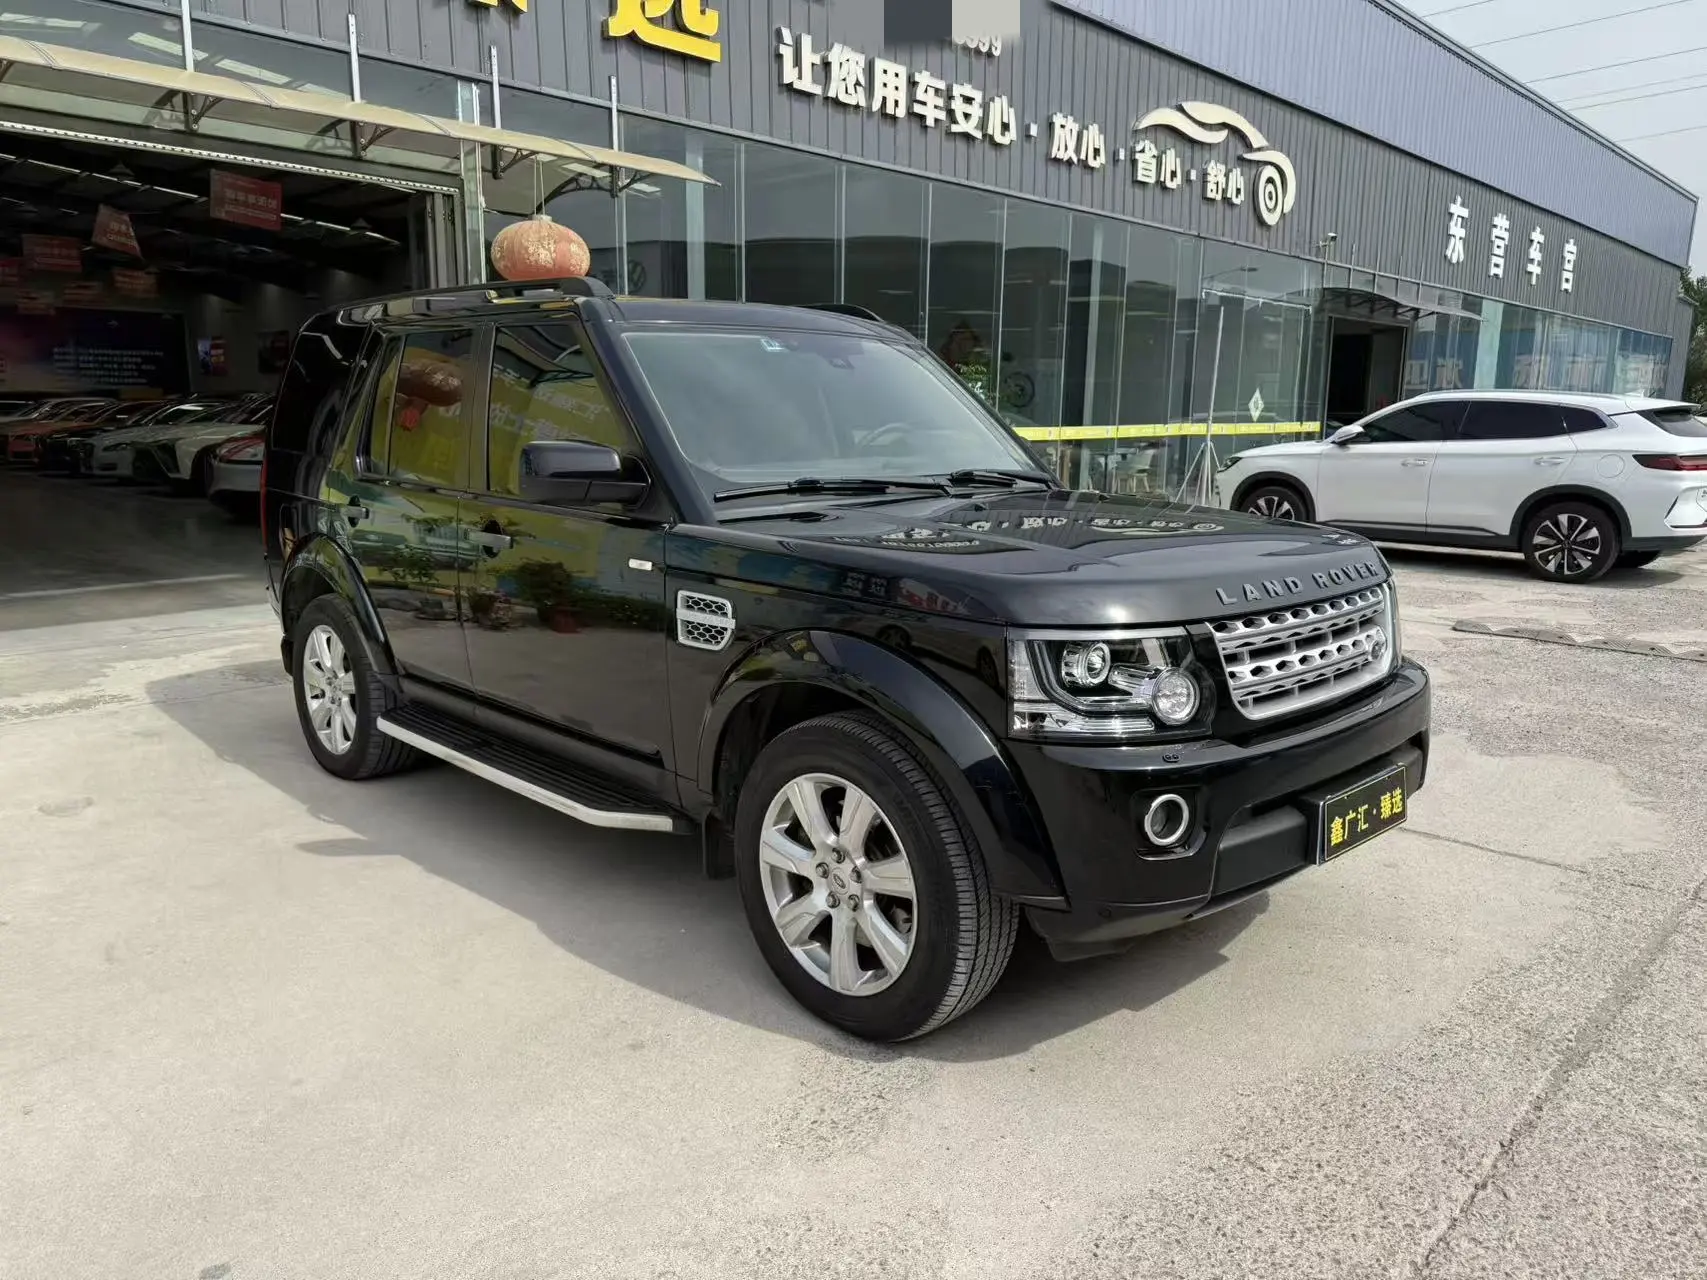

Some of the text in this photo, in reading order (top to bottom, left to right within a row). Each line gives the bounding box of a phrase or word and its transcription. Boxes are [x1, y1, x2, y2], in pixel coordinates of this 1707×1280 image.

[1444, 194, 1578, 293] 东营车宫
[1215, 560, 1379, 606] LAND ROVER
